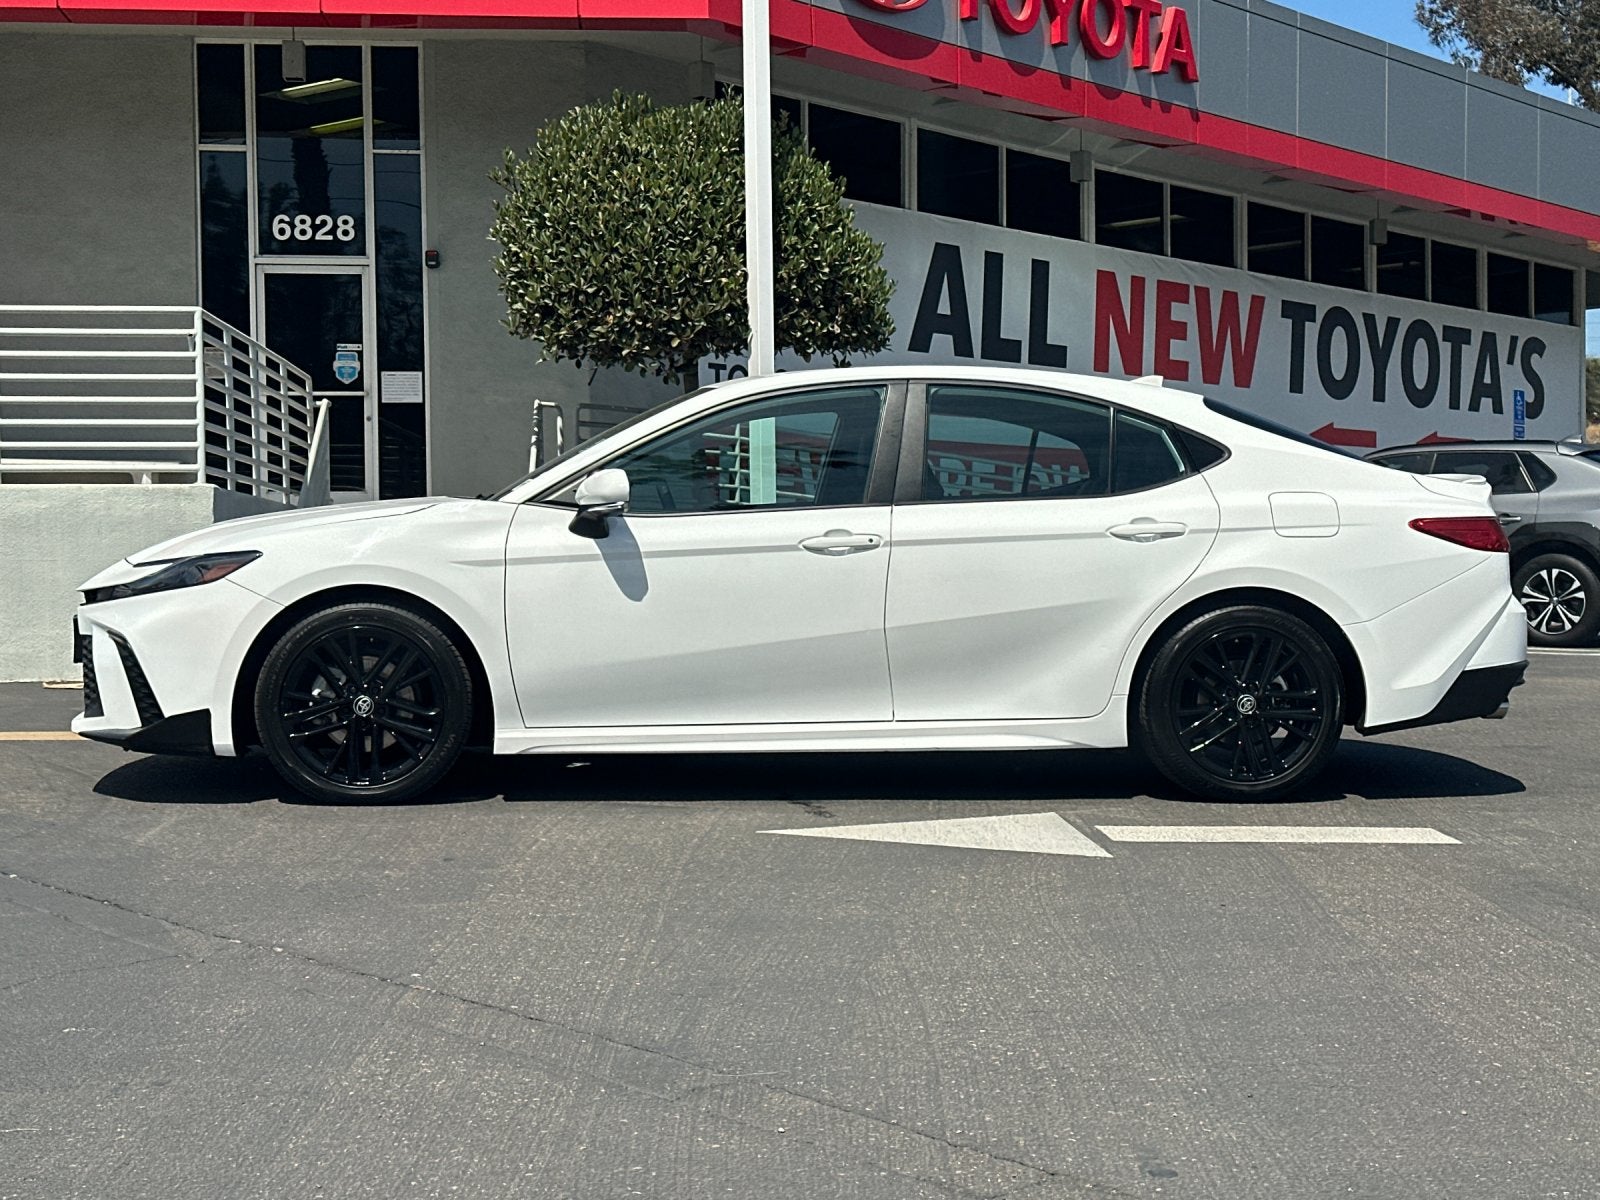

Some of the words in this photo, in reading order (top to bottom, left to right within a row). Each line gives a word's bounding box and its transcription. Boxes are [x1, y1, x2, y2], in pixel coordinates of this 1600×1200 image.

[272, 214, 355, 241] 6828
[908, 241, 1068, 368] ALL
[1093, 269, 1266, 388] NEW
[1281, 299, 1547, 420] TOYOTA'S
